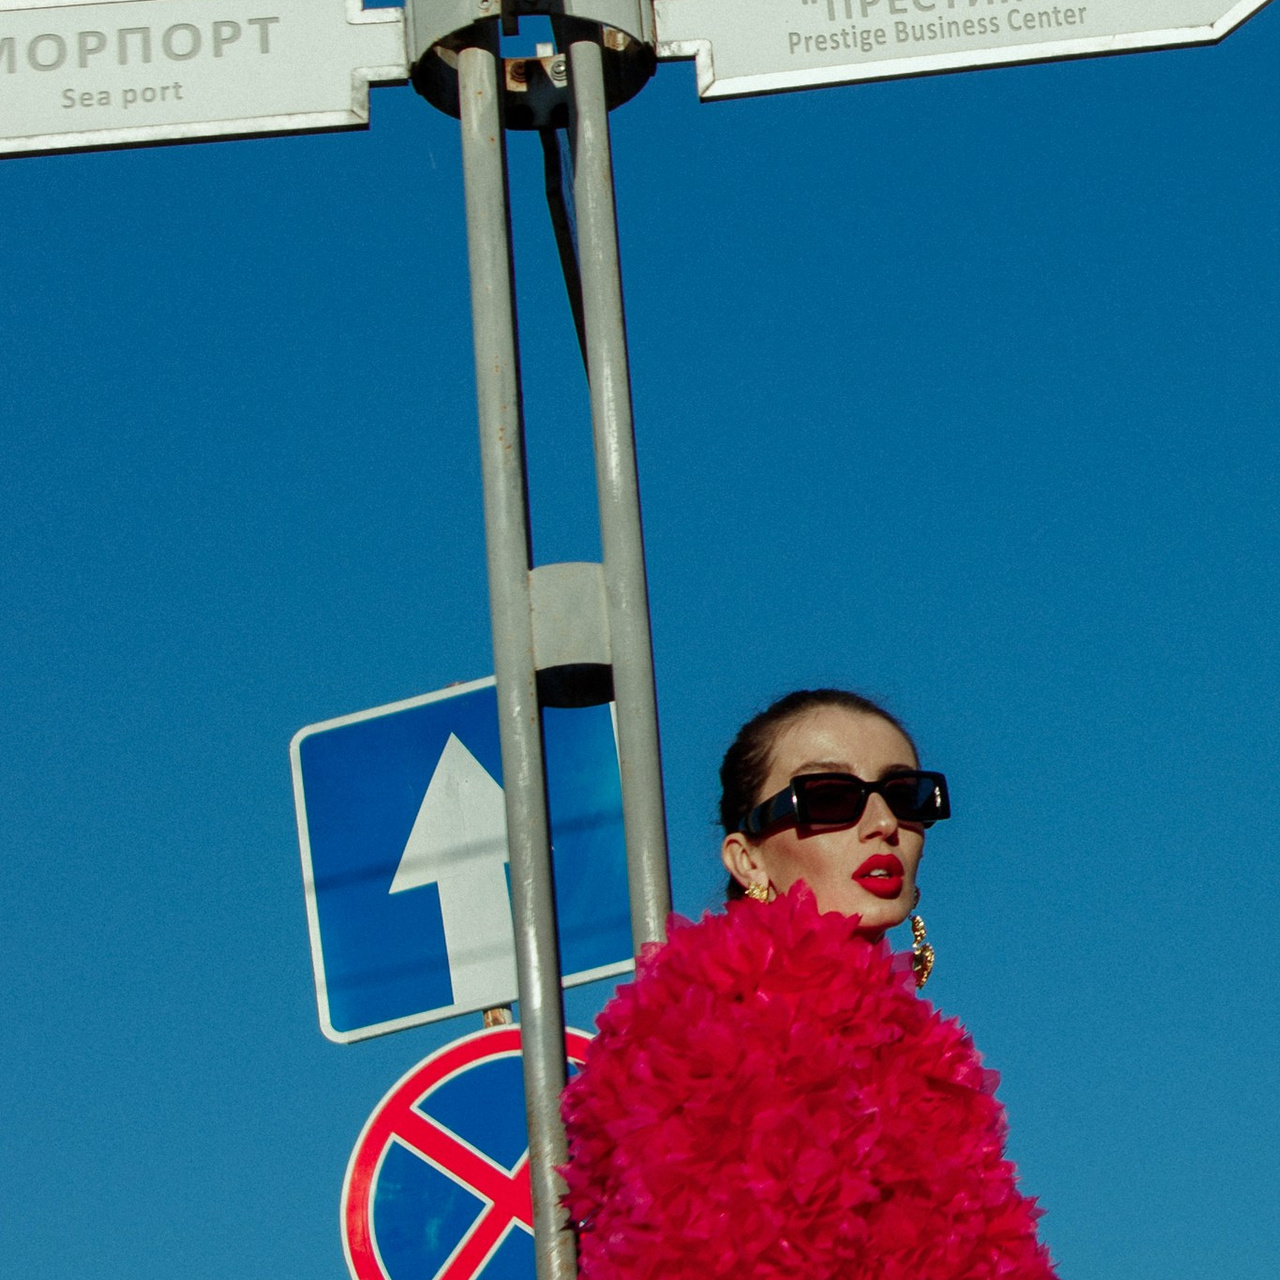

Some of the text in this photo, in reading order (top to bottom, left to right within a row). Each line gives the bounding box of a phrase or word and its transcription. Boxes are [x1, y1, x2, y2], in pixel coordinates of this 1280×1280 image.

[788, 6, 1088, 55] Prestige Business Center
[61, 81, 184, 110] Sea port
